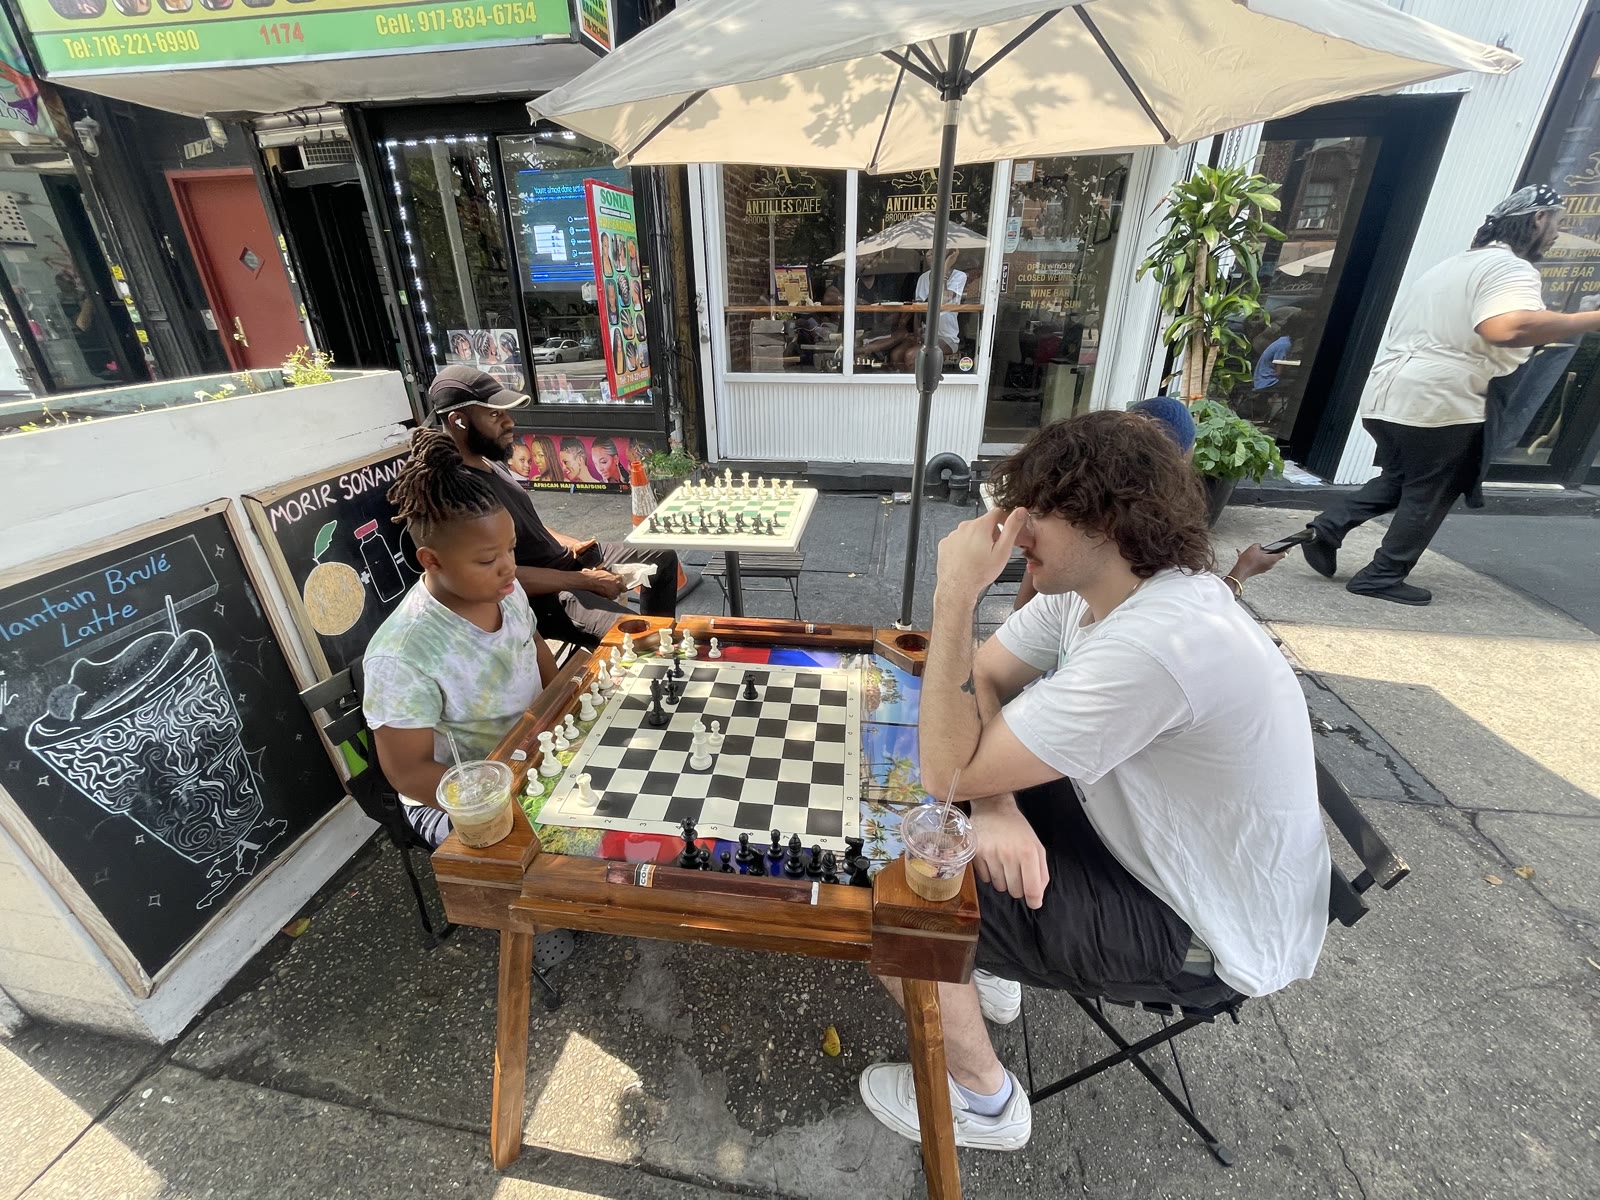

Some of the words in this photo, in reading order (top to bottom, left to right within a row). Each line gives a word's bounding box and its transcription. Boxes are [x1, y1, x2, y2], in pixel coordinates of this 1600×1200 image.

[375, 13, 415, 35] Cell:
[417, 1, 537, 32] 917-834-6754
[259, 21, 304, 45] 1174
[63, 38, 92, 58] Tel:
[92, 29, 200, 57] 718-221-6990
[0, 107, 36, 126] LON
[600, 188, 629, 210] SONIA
[746, 199, 793, 214] ANTILLES
[795, 198, 821, 213] CAFE
[886, 195, 938, 212] ANTILLES
[949, 194, 968, 209] AFE
[1564, 196, 1600, 214] TILL
[1018, 274, 1045, 282] CLOSED
[1540, 266, 1570, 278] WINE
[1570, 266, 1594, 277] BAR
[1030, 288, 1052, 298] WINE
[1053, 288, 1070, 297] BAR
[1550, 281, 1574, 292] SAT
[1020, 300, 1034, 309] FRI
[1064, 300, 1081, 309] SUN
[270, 484, 337, 532] MORIR
[339, 458, 409, 500] SOÑAND
[0, 590, 95, 642] lantain
[105, 553, 171, 594] Brulé
[61, 603, 138, 648] Latte
